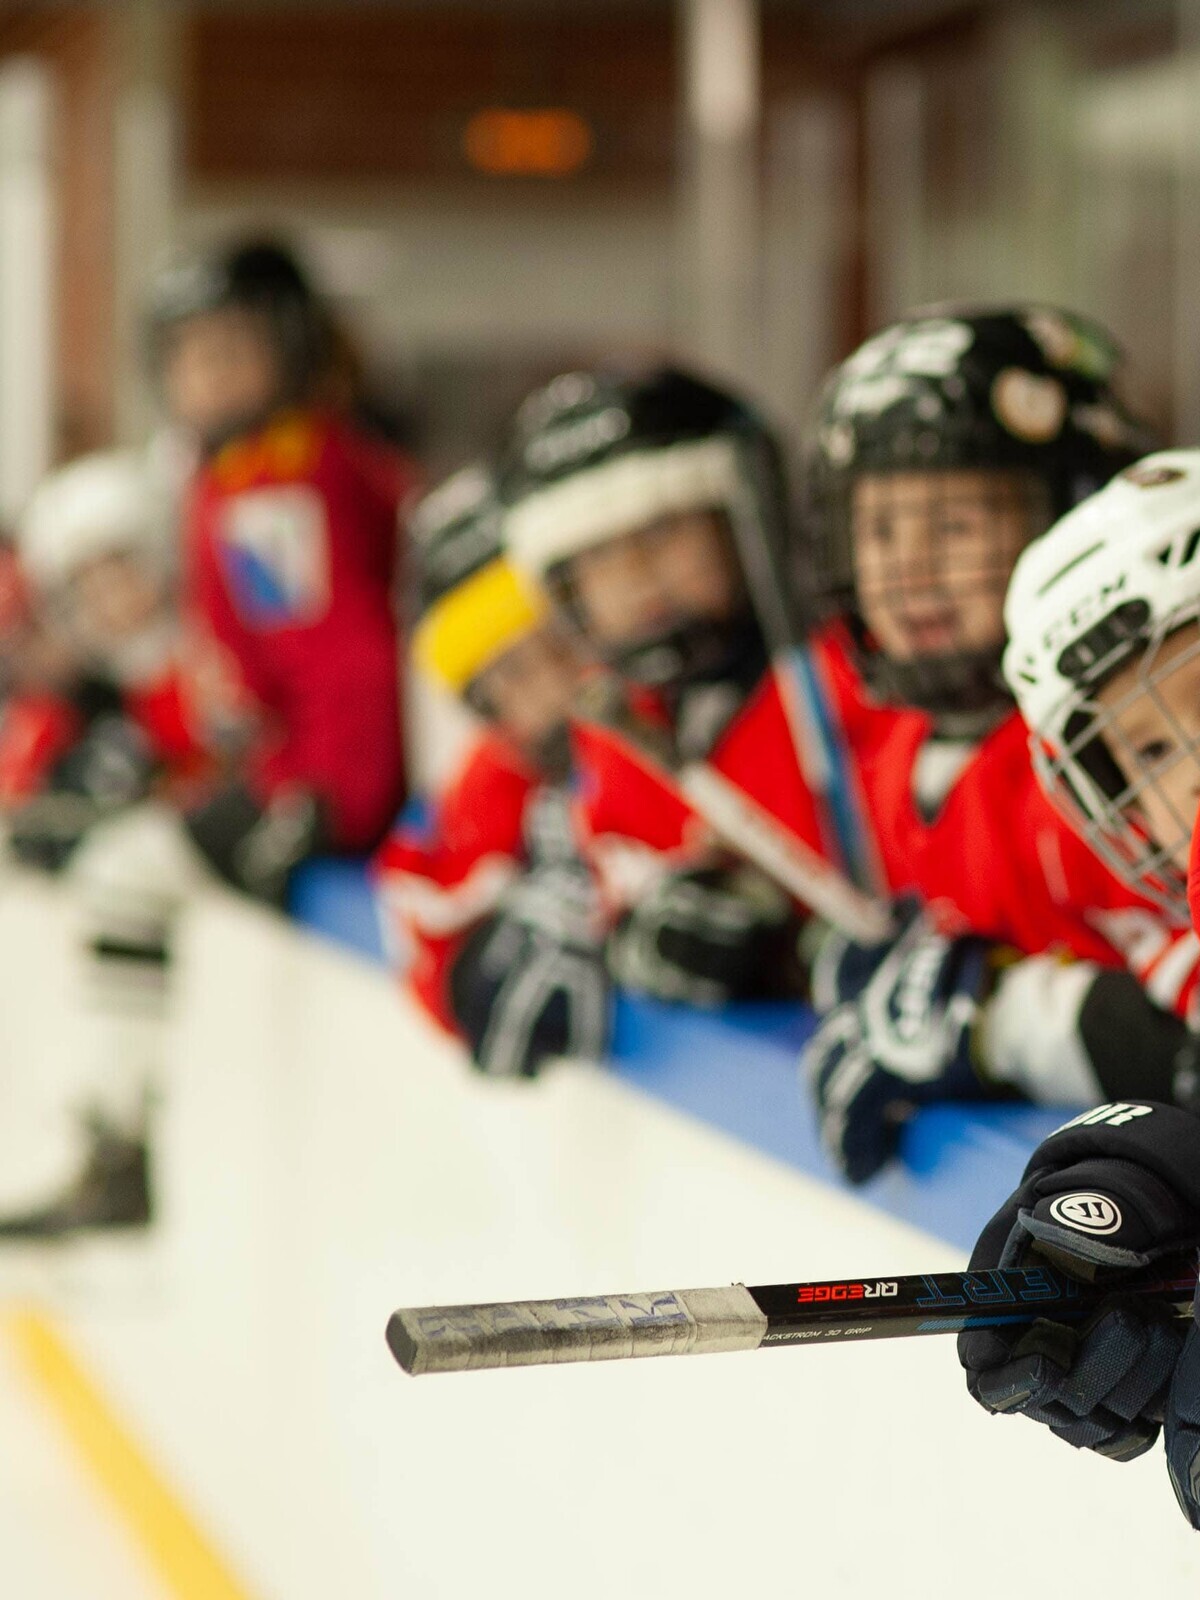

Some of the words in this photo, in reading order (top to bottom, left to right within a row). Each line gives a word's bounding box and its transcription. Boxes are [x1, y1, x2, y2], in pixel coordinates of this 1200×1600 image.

[798, 1282, 898, 1303] QREDGE
[762, 1330, 821, 1341] ACKSTROM
[844, 1326, 873, 1336] GRIP
